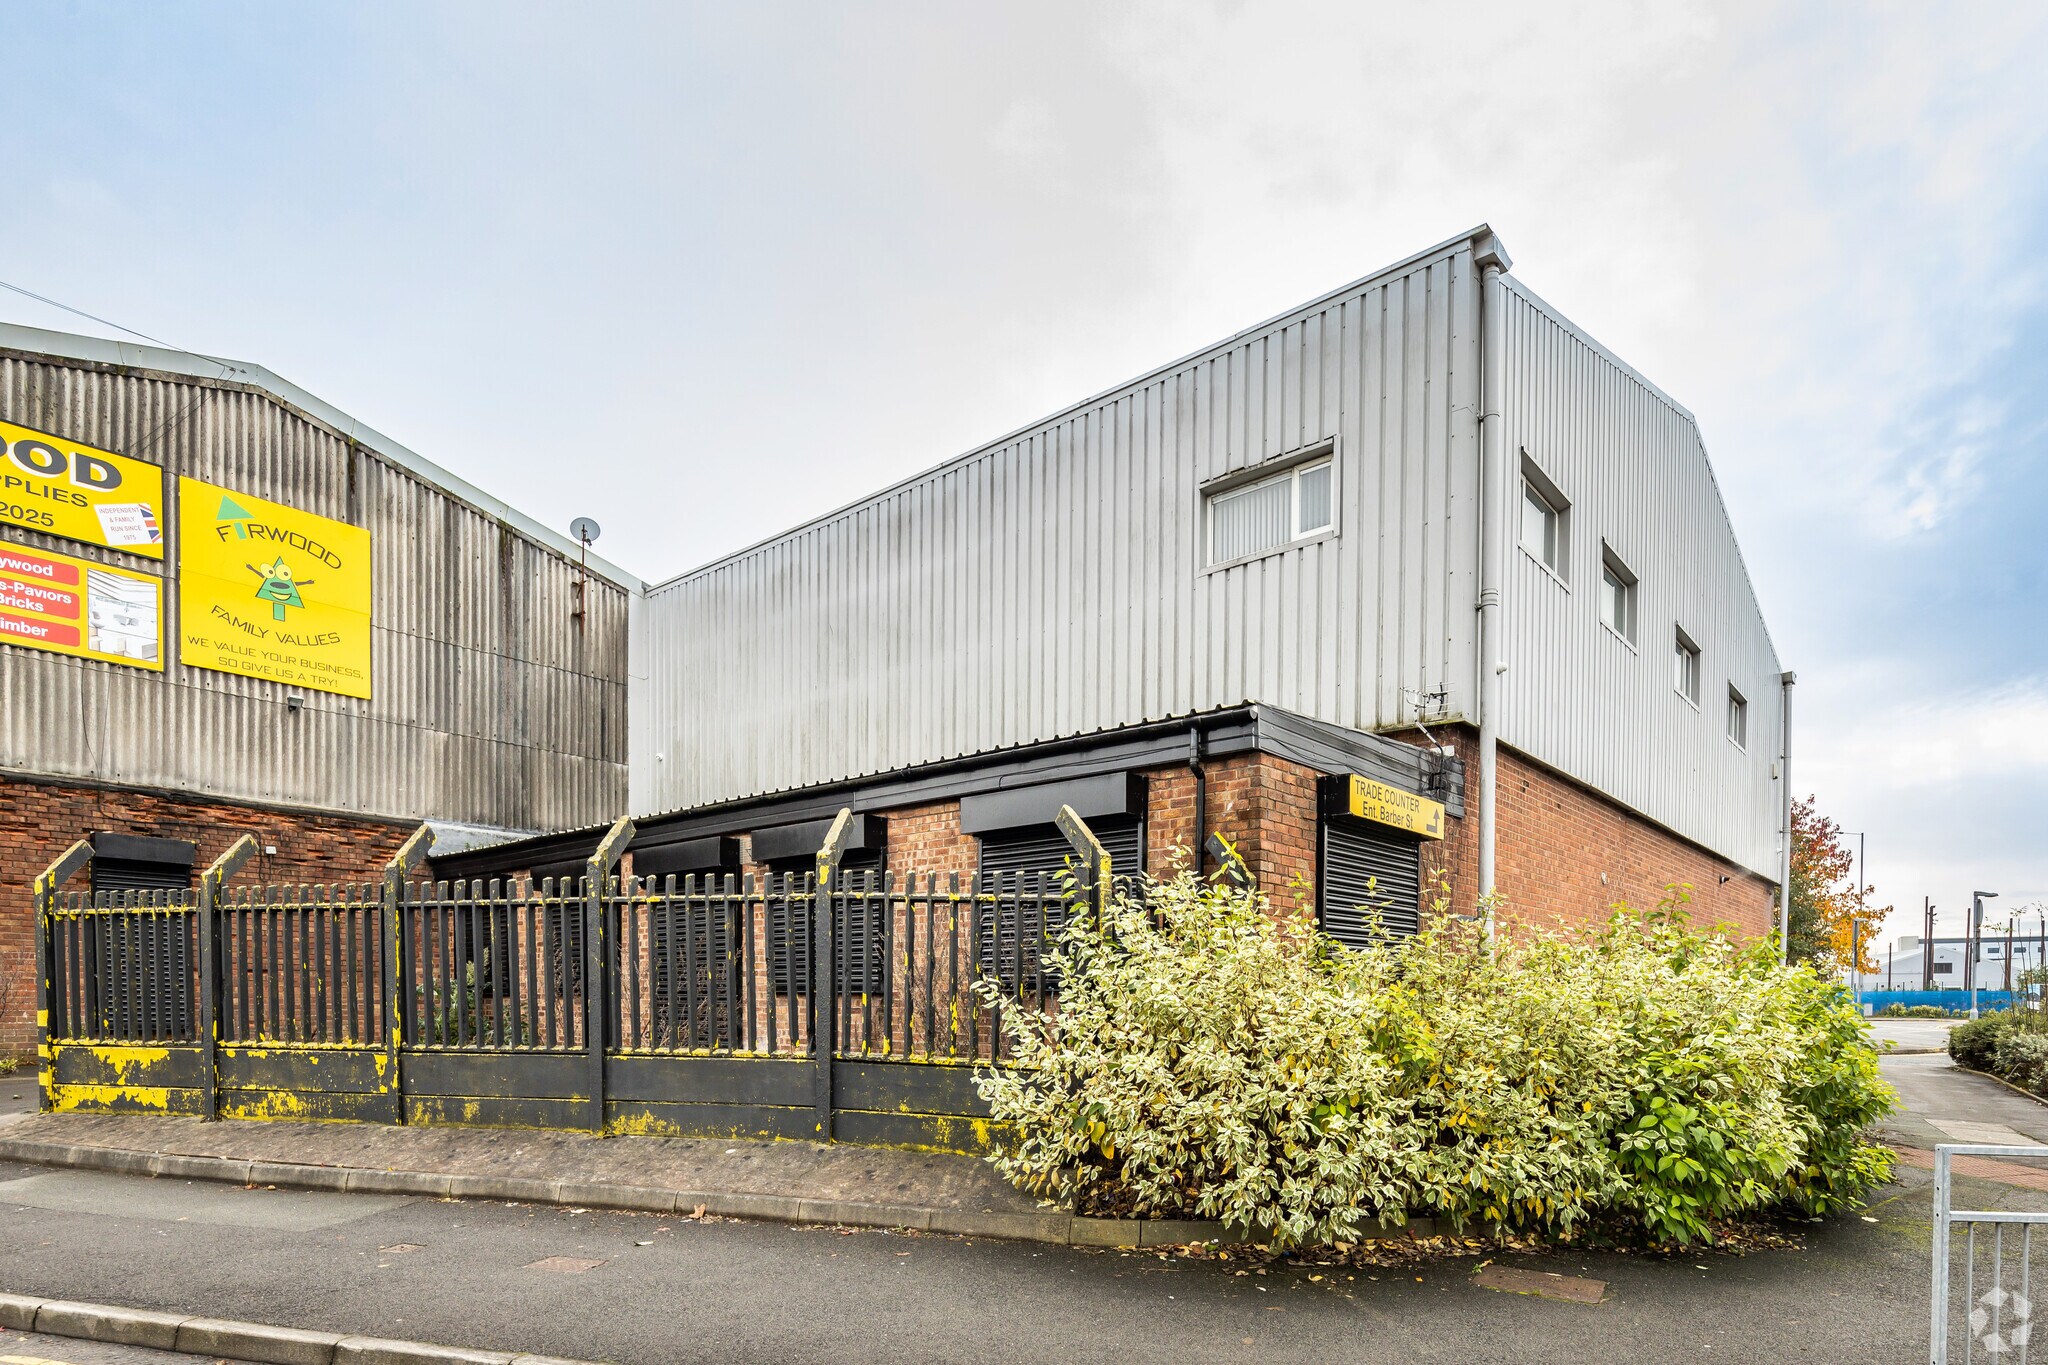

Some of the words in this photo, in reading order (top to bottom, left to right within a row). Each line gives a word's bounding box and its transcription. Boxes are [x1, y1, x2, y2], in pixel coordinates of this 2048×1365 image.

[0, 436, 122, 492] OD
[0, 473, 88, 508] PLIES
[216, 522, 342, 570] FIRWOOD
[211, 605, 269, 639] FAMILY
[275, 632, 341, 647] VALUES
[187, 635, 209, 648] WE
[214, 640, 256, 658] VALUE
[261, 651, 297, 666] YOUR
[218, 656, 238, 668] SO
[242, 661, 271, 675] GIVE
[276, 668, 294, 679] US
[298, 672, 306, 682] A
[310, 675, 338, 688] TRY!
[1355, 779, 1382, 801] TRADE
[1384, 789, 1420, 813] COUNTER
[1363, 801, 1378, 818] Ent.
[1380, 806, 1405, 825] Barber
[1406, 814, 1413, 829] St
